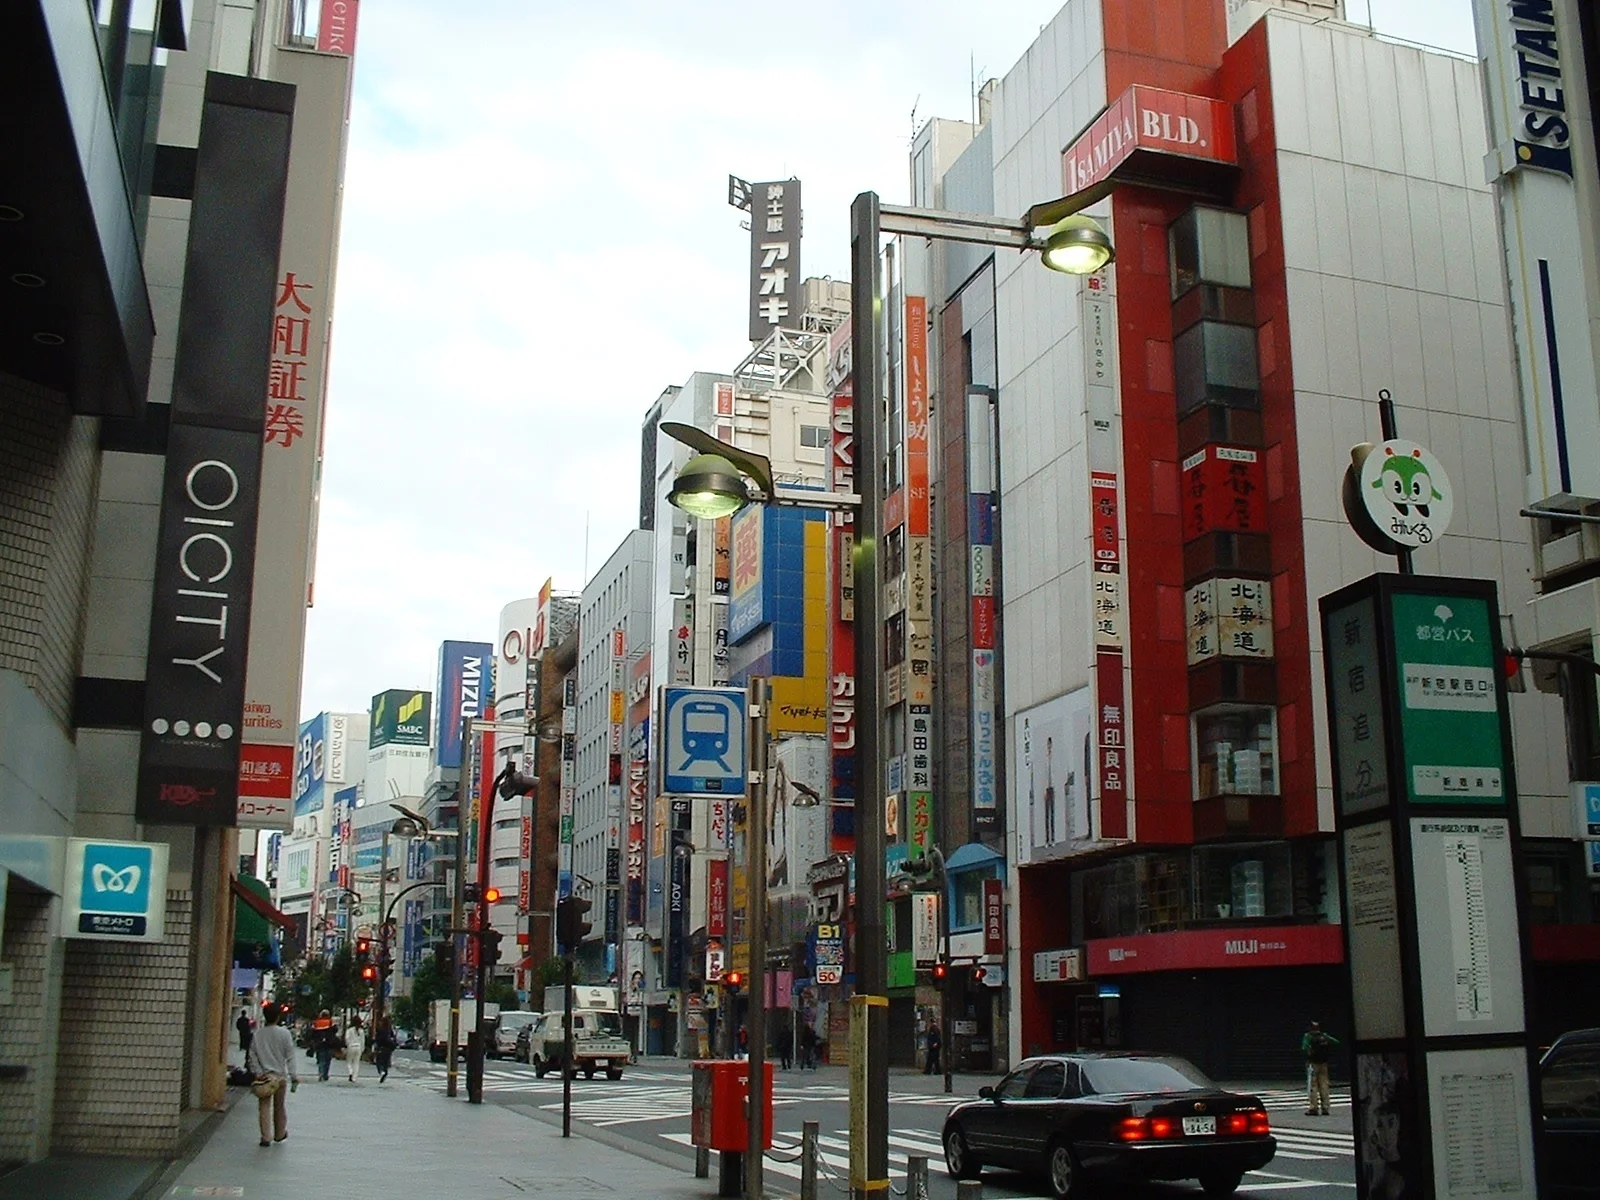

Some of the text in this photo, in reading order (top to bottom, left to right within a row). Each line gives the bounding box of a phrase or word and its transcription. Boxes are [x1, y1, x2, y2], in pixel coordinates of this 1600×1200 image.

[1068, 108, 1208, 194] ISAMIYA BLD.
[759, 241, 789, 325] アオキ
[264, 272, 313, 447] 大和証券
[908, 356, 928, 440] しょう助
[1391, 516, 1432, 543] みんくる
[716, 582, 729, 591] 9F
[1096, 581, 1117, 636] 北海道
[1191, 590, 1210, 655] 北海道
[1231, 583, 1259, 653] 北海道
[1416, 624, 1475, 643] 都営バス
[460, 656, 482, 717] MIZU
[244, 700, 271, 713] aiwa
[244, 715, 282, 729] urities
[397, 724, 423, 735] SMBC
[1104, 704, 1122, 790] 無印良品
[241, 761, 282, 775] 和証券
[629, 763, 644, 825] さくらや
[673, 802, 688, 812] 4F
[238, 803, 286, 816] Mコーナー
[628, 841, 641, 880] メガネ
[671, 882, 682, 912] AOKI
[817, 924, 840, 938] B1
[1226, 939, 1258, 955] MUJI
